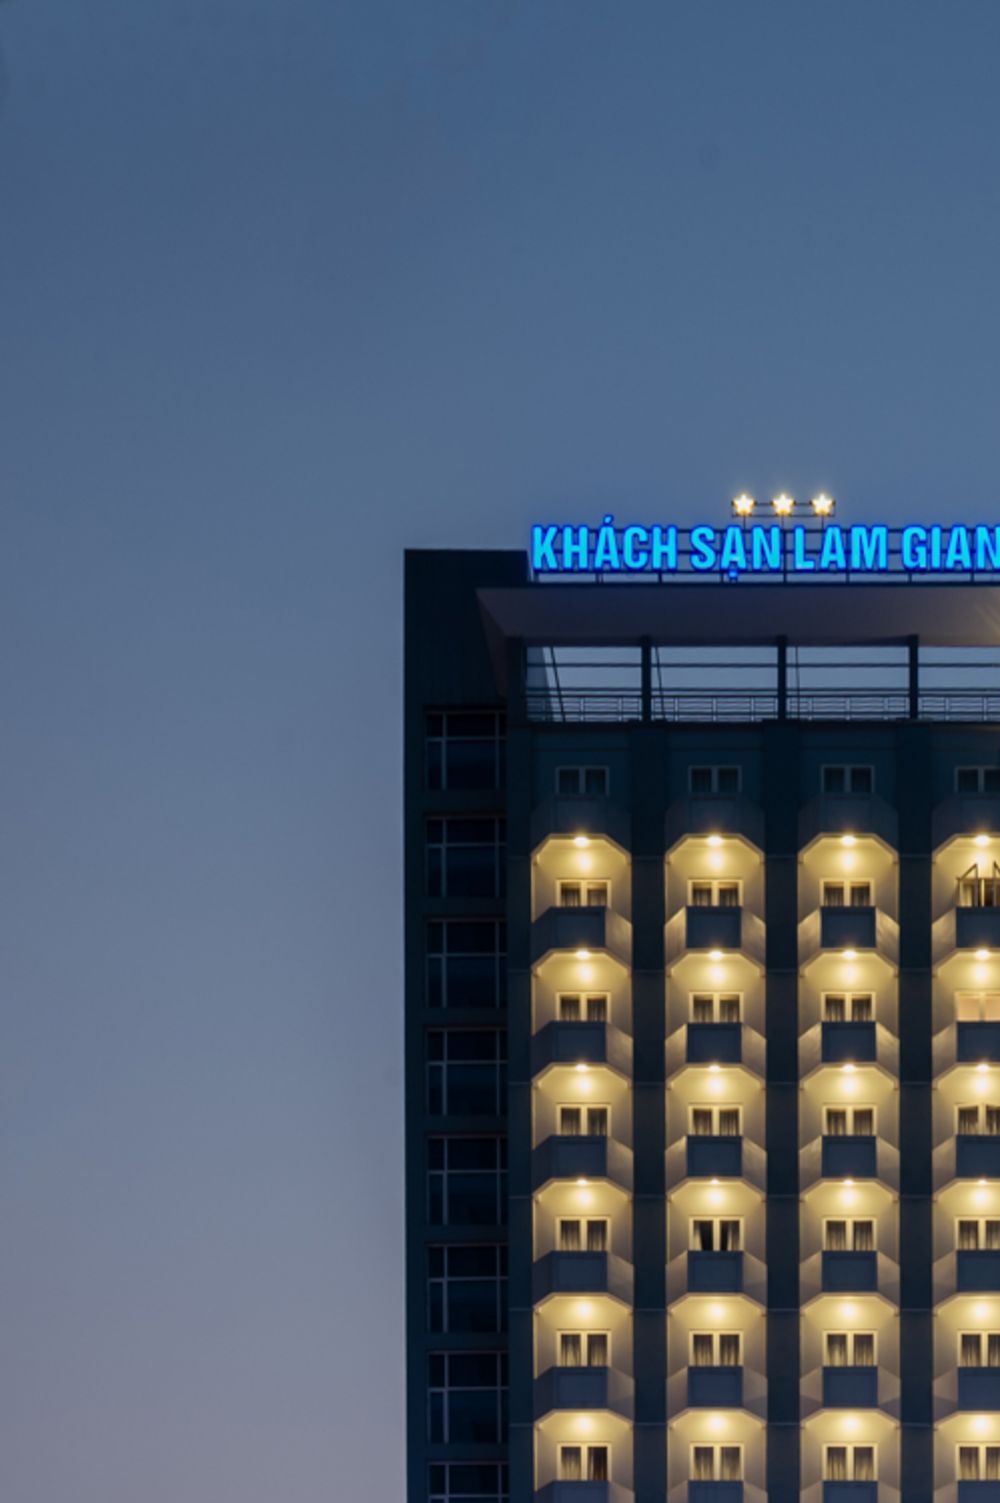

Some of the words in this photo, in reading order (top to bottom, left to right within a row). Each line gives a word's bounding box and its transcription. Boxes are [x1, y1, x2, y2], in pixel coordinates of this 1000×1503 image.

[531, 514, 679, 569] KHÁCH
[690, 524, 783, 579] SẠN
[794, 524, 890, 569] LAM
